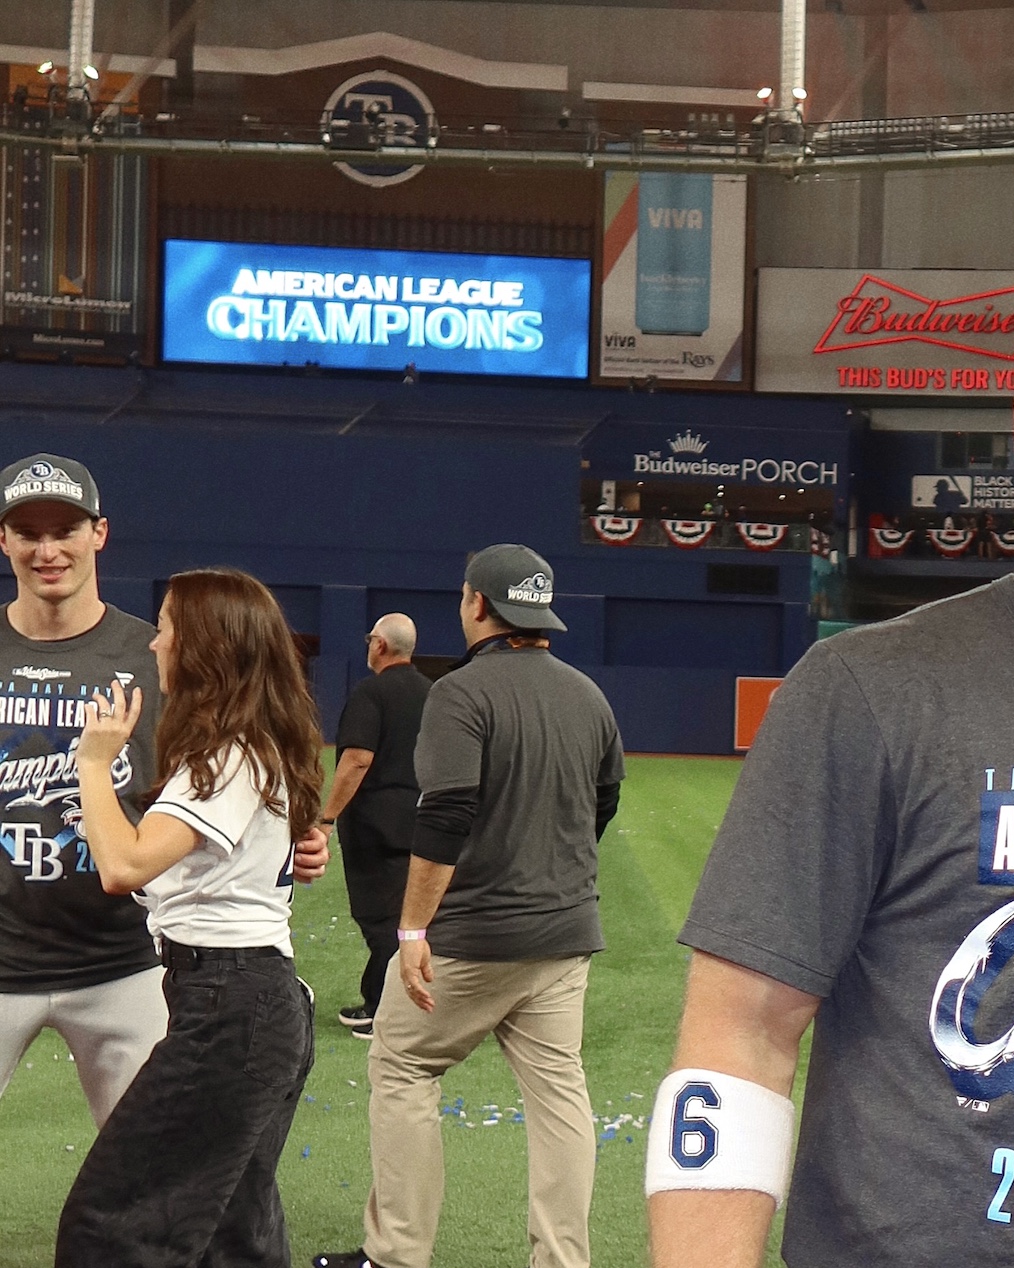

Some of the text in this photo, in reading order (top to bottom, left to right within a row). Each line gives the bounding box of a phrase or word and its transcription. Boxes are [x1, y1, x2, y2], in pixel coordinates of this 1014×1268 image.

[648, 208, 703, 229] VIVA
[231, 268, 524, 308] AMERICAN LEAGUE
[206, 295, 545, 351] CHAMPIONS
[837, 367, 881, 388] THIS
[886, 368, 946, 389] BUD'S
[951, 370, 989, 390] FOR
[633, 454, 838, 485] Budweiser PORCH
[974, 476, 1013, 486] BLACK
[4, 480, 83, 501] WORLD SERIES
[508, 588, 540, 602] WORLD
[0, 696, 50, 726] RICAN
[1, 822, 64, 882] TB
[669, 1081, 722, 1171] 6
